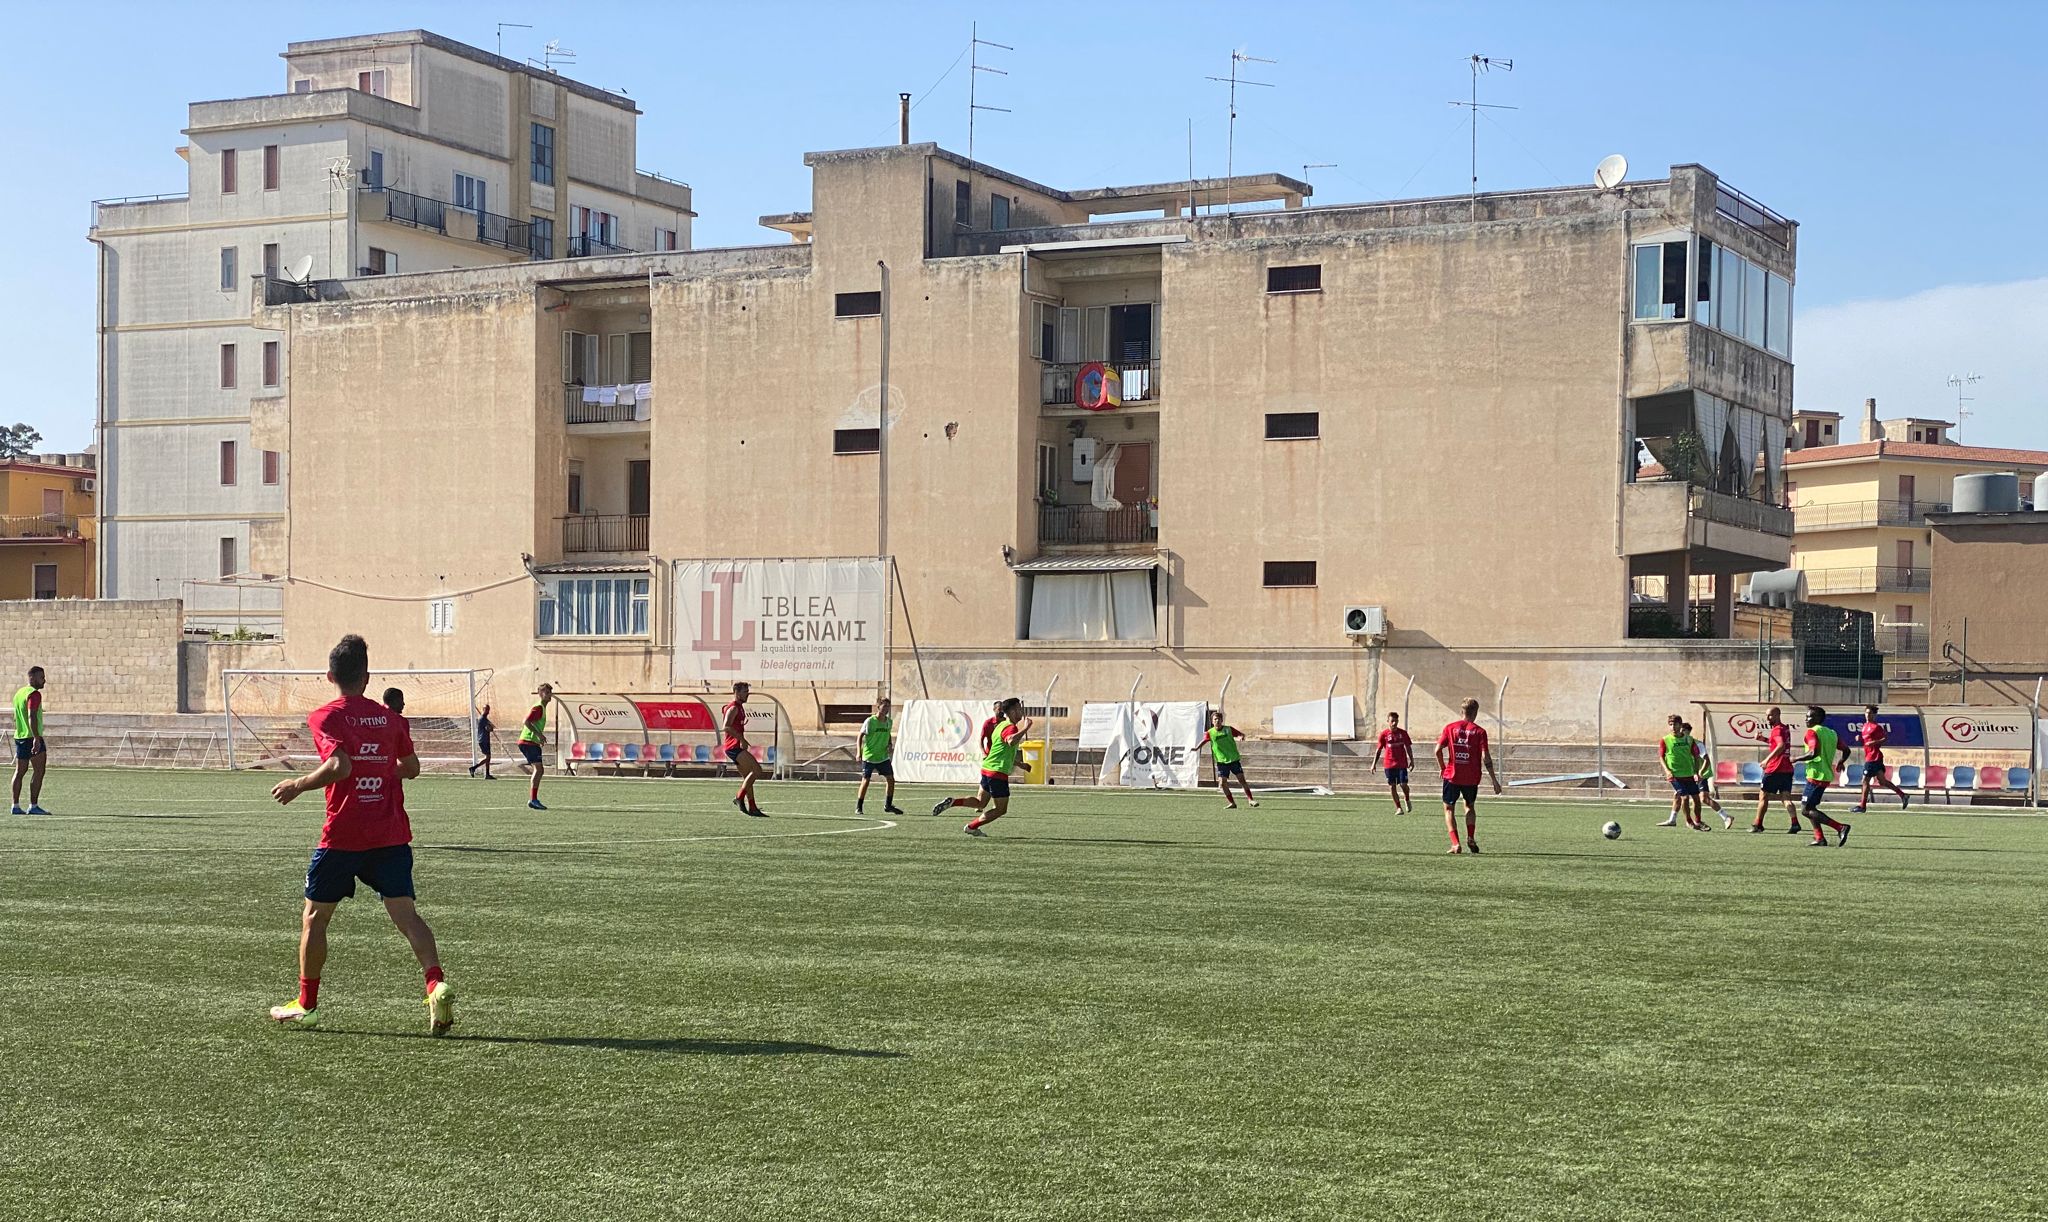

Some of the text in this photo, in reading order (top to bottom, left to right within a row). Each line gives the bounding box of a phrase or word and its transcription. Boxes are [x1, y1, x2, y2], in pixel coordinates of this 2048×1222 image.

[761, 596, 837, 617] IBLEA
[761, 620, 867, 641] LEGNAMI
[761, 644, 833, 654] la qualità nel legno
[760, 659, 835, 672] iblealegnami.it
[659, 709, 692, 719] LOCALI
[360, 716, 387, 725] PITINO
[1847, 722, 1892, 732] OSTI
